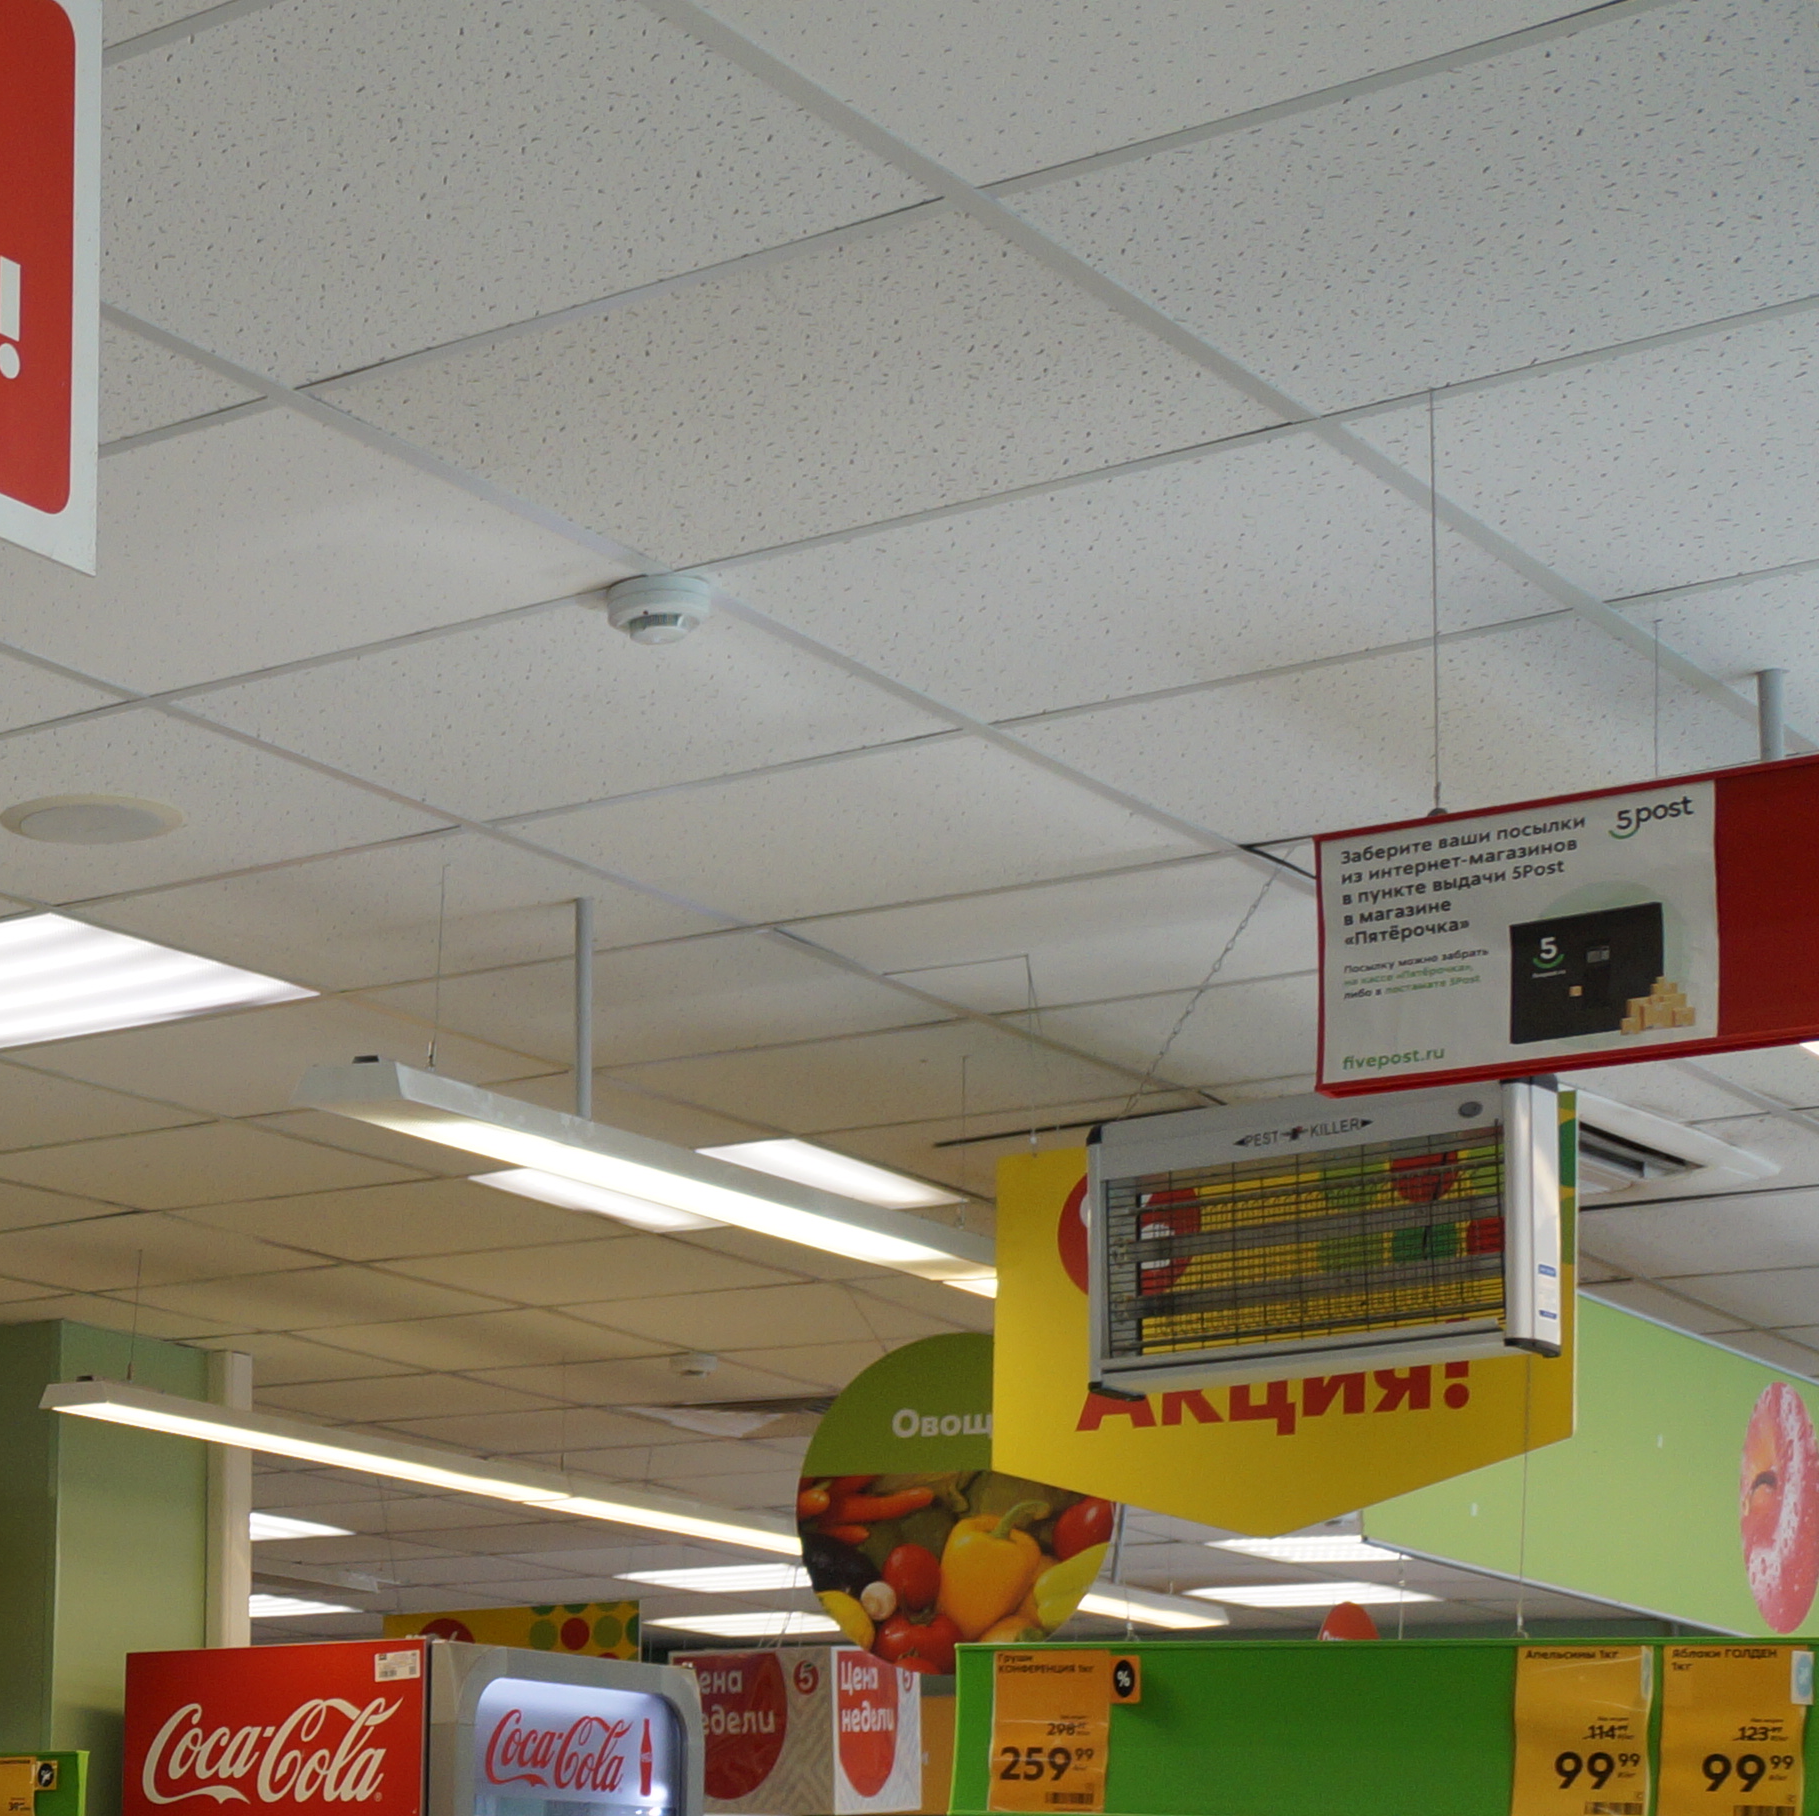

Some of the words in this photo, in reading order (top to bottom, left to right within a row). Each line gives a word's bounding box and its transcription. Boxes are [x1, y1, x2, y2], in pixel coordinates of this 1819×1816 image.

[1614, 795, 1695, 833] 5post
[1340, 836, 1433, 865] Заберите
[1437, 829, 1491, 851] ваши
[1496, 814, 1587, 842] посылки
[1341, 869, 1362, 886] из
[1367, 836, 1578, 882] интернет-магазинов
[1341, 892, 1352, 905] в
[1357, 880, 1426, 909] пункте
[1432, 869, 1506, 897] выдачи
[1511, 859, 1565, 882] 5Post
[1343, 914, 1354, 926] в
[1358, 899, 1452, 926] магазине
[1344, 917, 1470, 948] «Пятёрочка»
[1539, 937, 1558, 959] 5
[1342, 1048, 1445, 1070] fivepost.ru
[1243, 1128, 1280, 1148] PEST
[1309, 1115, 1363, 1138] KILLER
[892, 1407, 994, 1439] Овощ
[998, 1664, 1076, 1675] КОНФЕРЕНЦИЯ
[1525, 1649, 1597, 1660] Апельсины
[840, 1660, 878, 1692] Цена
[703, 1706, 776, 1736] едели
[841, 1700, 895, 1732] недели
[141, 1696, 404, 1806] Coca-Cola
[484, 1709, 633, 1794] Coca-Cola
[999, 1746, 1072, 1782] 259
[1074, 1748, 1094, 1760] 99
[1554, 1751, 1615, 1790] 99
[1617, 1753, 1641, 1767] 99
[1701, 1753, 1766, 1792] 99
[1769, 1755, 1795, 1769] 99
